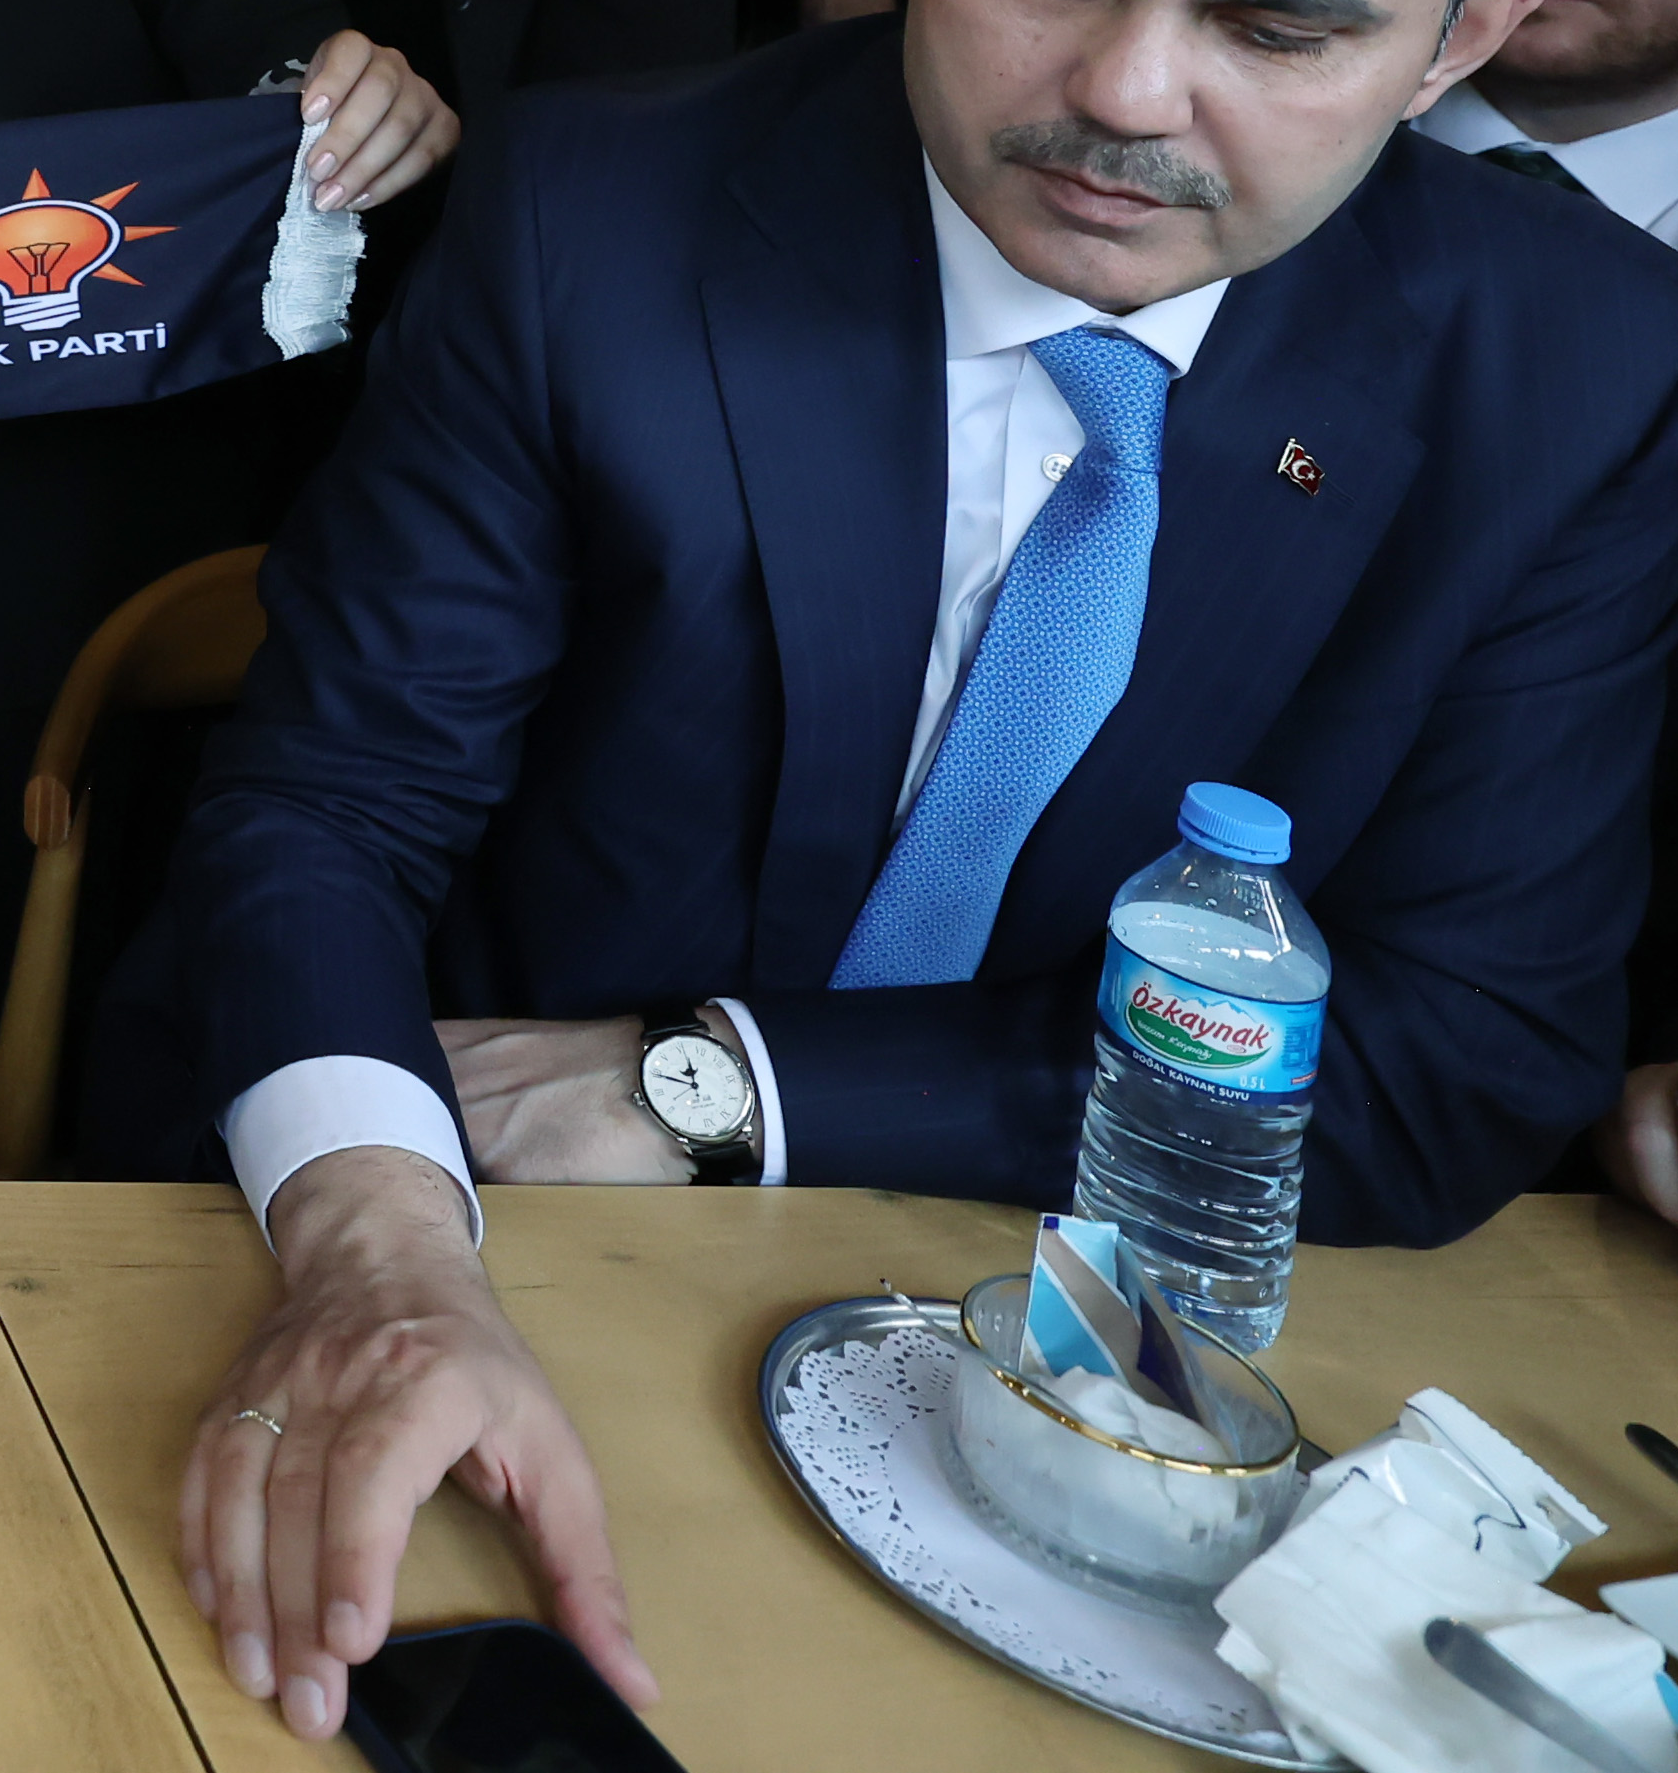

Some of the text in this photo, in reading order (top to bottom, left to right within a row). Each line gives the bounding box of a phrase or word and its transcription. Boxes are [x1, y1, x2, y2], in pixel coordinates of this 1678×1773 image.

[29, 322, 168, 363] PARTİ
[1132, 981, 1270, 1050] Özkaynak
[1132, 1050, 1250, 1102] DOĞAL KAYNAK SUYU
